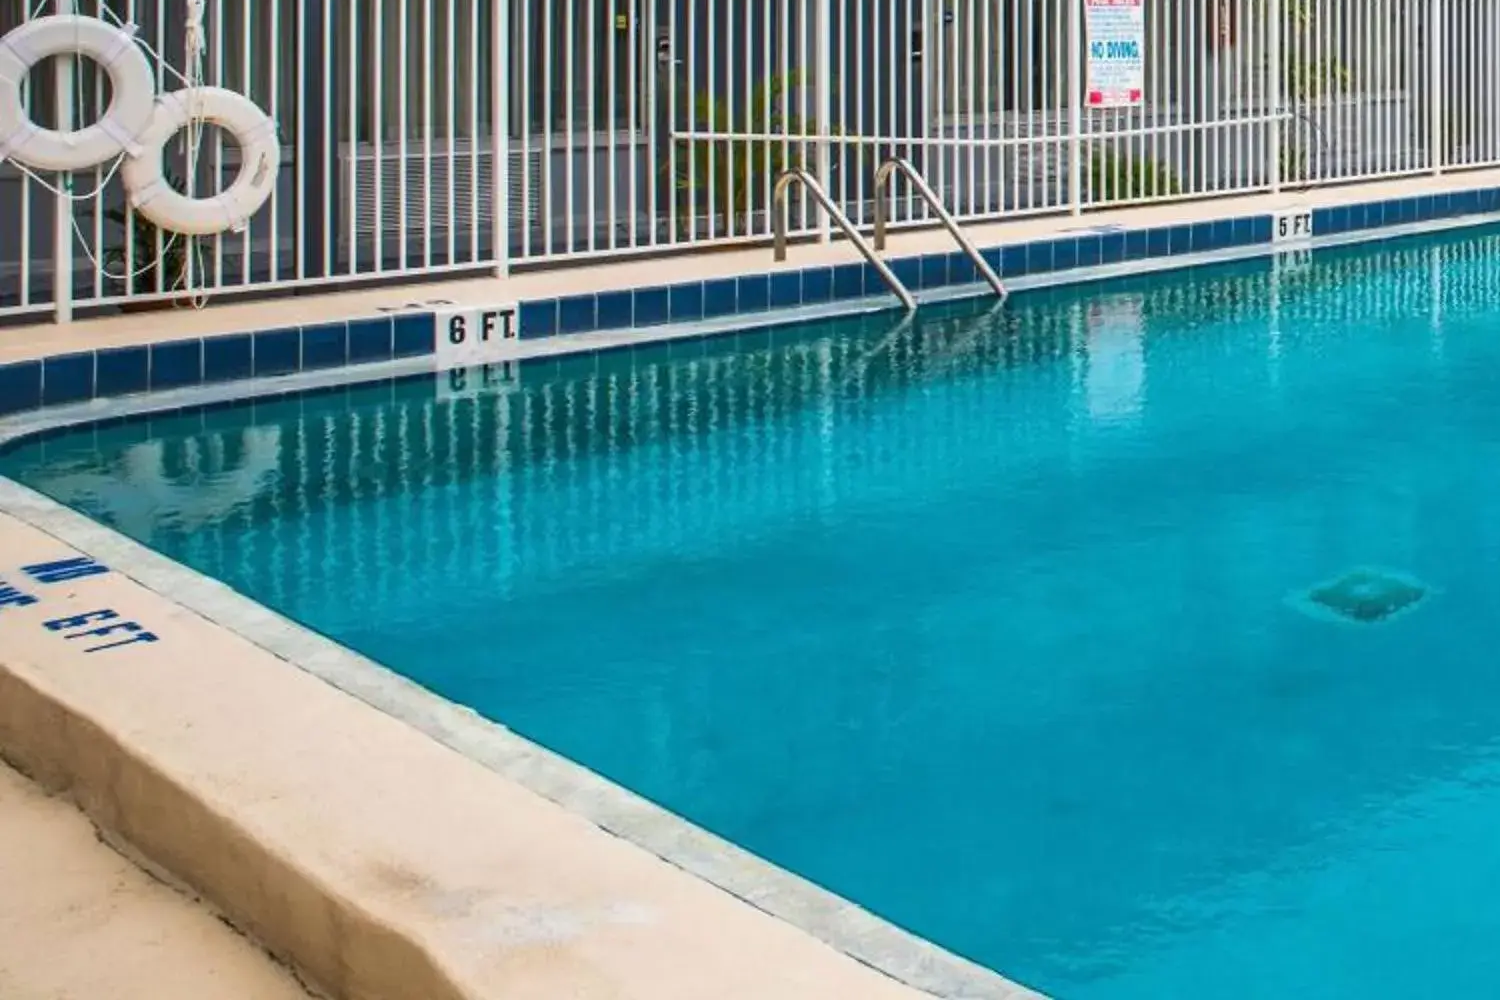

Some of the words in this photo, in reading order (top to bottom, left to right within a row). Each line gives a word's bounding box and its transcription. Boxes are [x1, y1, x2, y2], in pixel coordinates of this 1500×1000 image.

[1091, 40, 1104, 59] NO
[1106, 41, 1139, 59] DIVING
[1279, 217, 1287, 237] 5
[449, 315, 466, 345] 6
[42, 608, 160, 652] 6FT
